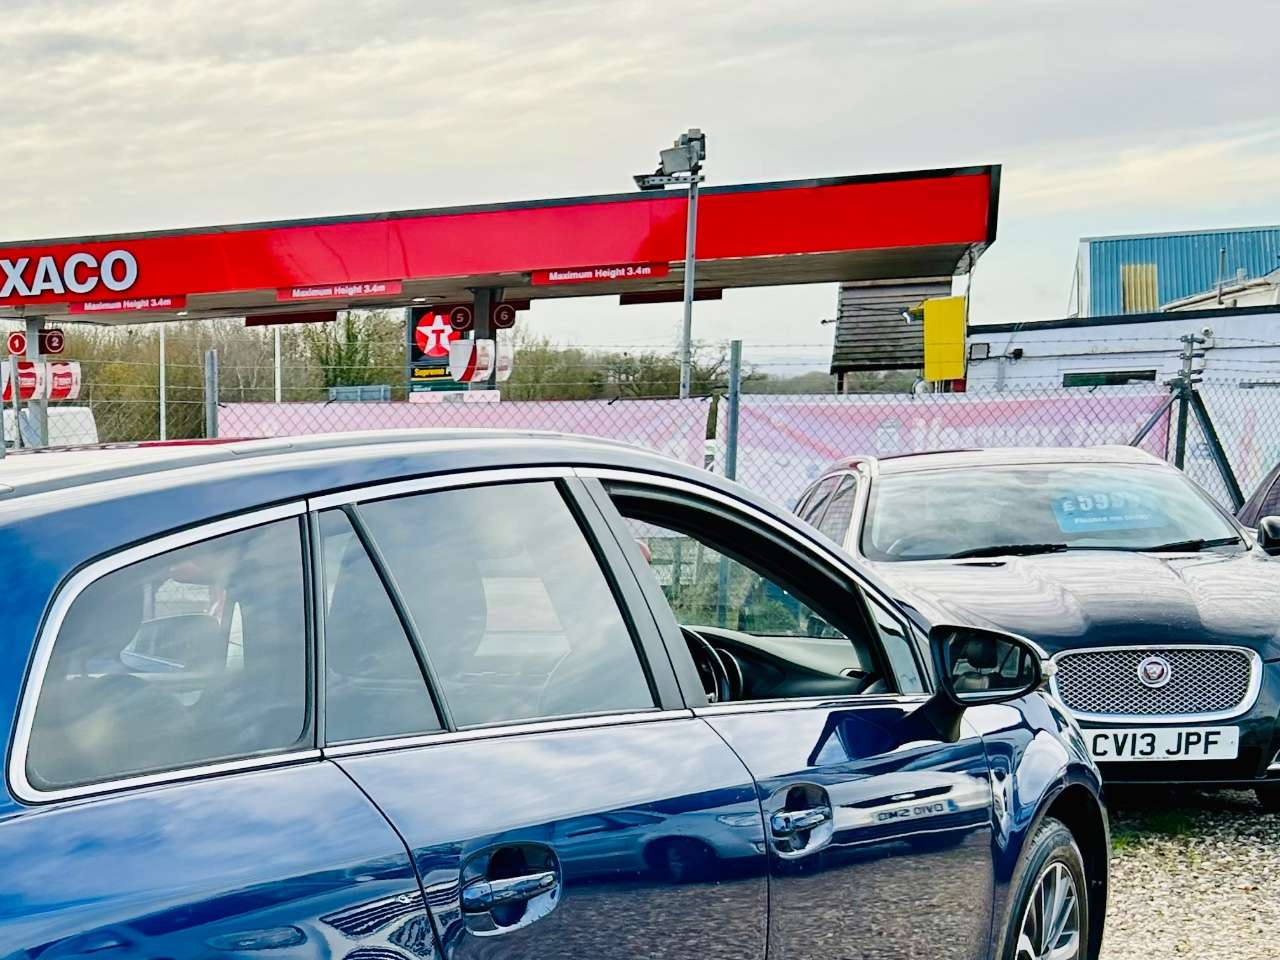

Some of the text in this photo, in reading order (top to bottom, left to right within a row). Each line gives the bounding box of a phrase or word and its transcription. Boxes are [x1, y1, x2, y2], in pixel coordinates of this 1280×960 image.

[549, 266, 651, 281] Maximum Height 3.4m
[292, 283, 386, 298] Maximum Height 3.4m
[83, 297, 172, 311] Maximum Height 3.4m
[456, 313, 464, 323] 5
[500, 311, 509, 321] 6
[13, 338, 19, 349] 1
[51, 336, 59, 347] 2
[1092, 731, 1222, 757] CV13 JPF
